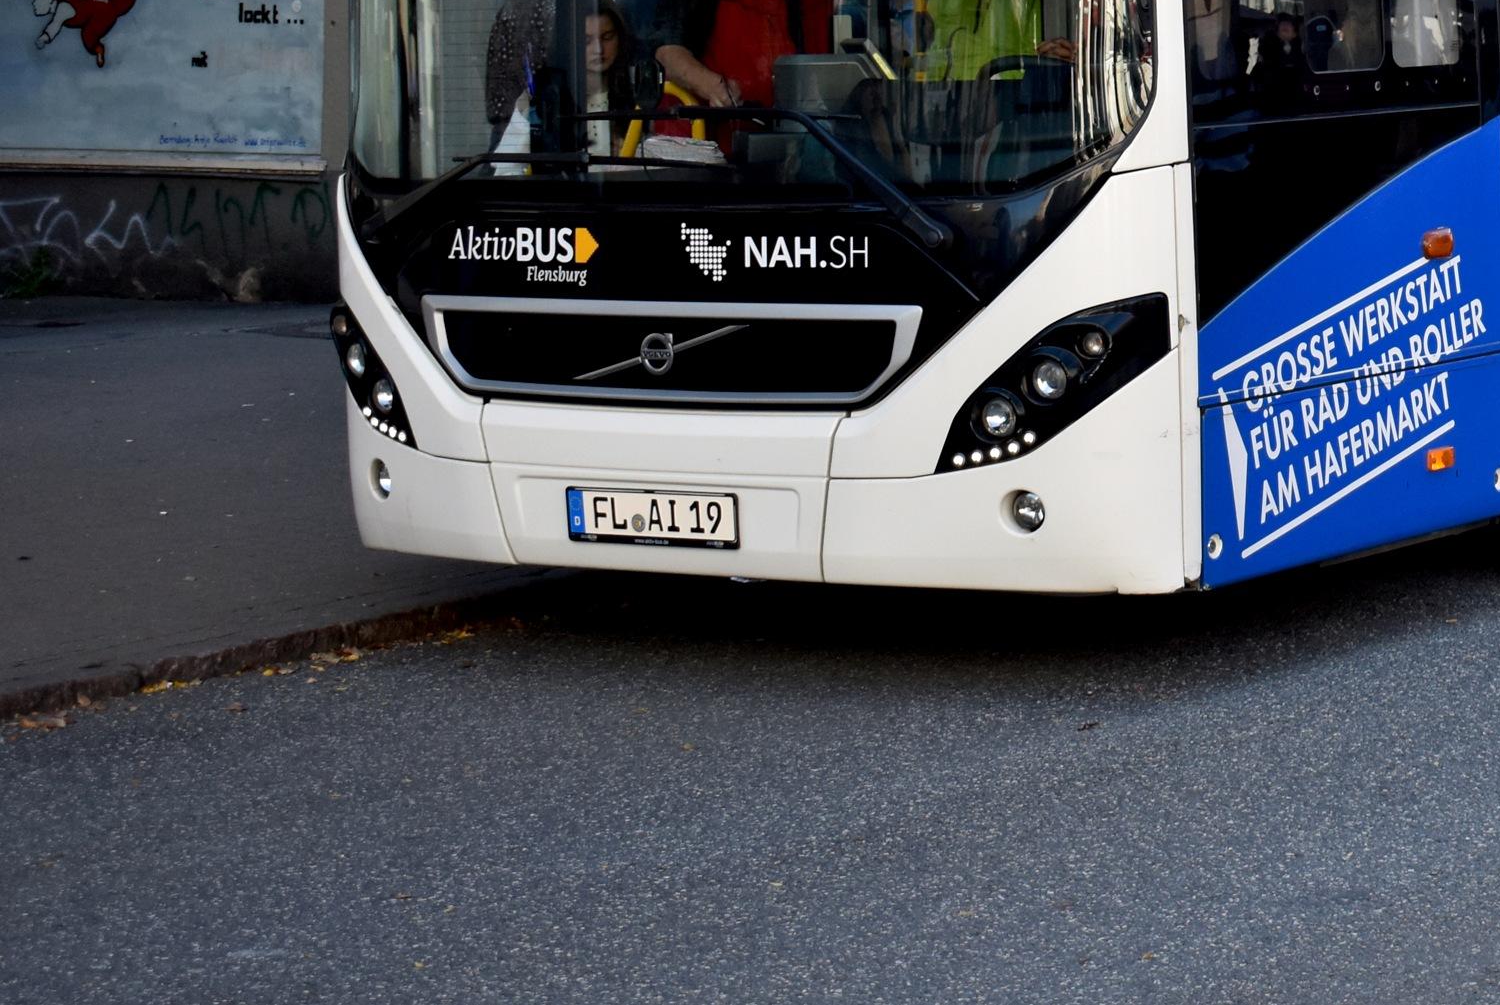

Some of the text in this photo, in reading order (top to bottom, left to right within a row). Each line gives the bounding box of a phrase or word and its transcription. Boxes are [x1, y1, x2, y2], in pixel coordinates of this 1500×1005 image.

[238, 2, 279, 24] lockt
[448, 226, 573, 264] AktivBUS
[743, 235, 869, 269] NAH.SH
[526, 265, 587, 287] Flensburg
[1242, 255, 1461, 412] GROSSE WERKSTATT
[1250, 298, 1487, 469] FÜR RAD UND ROLLER
[1261, 371, 1451, 524] AM HAFERMARKT
[593, 496, 722, 534] FL AI 19
